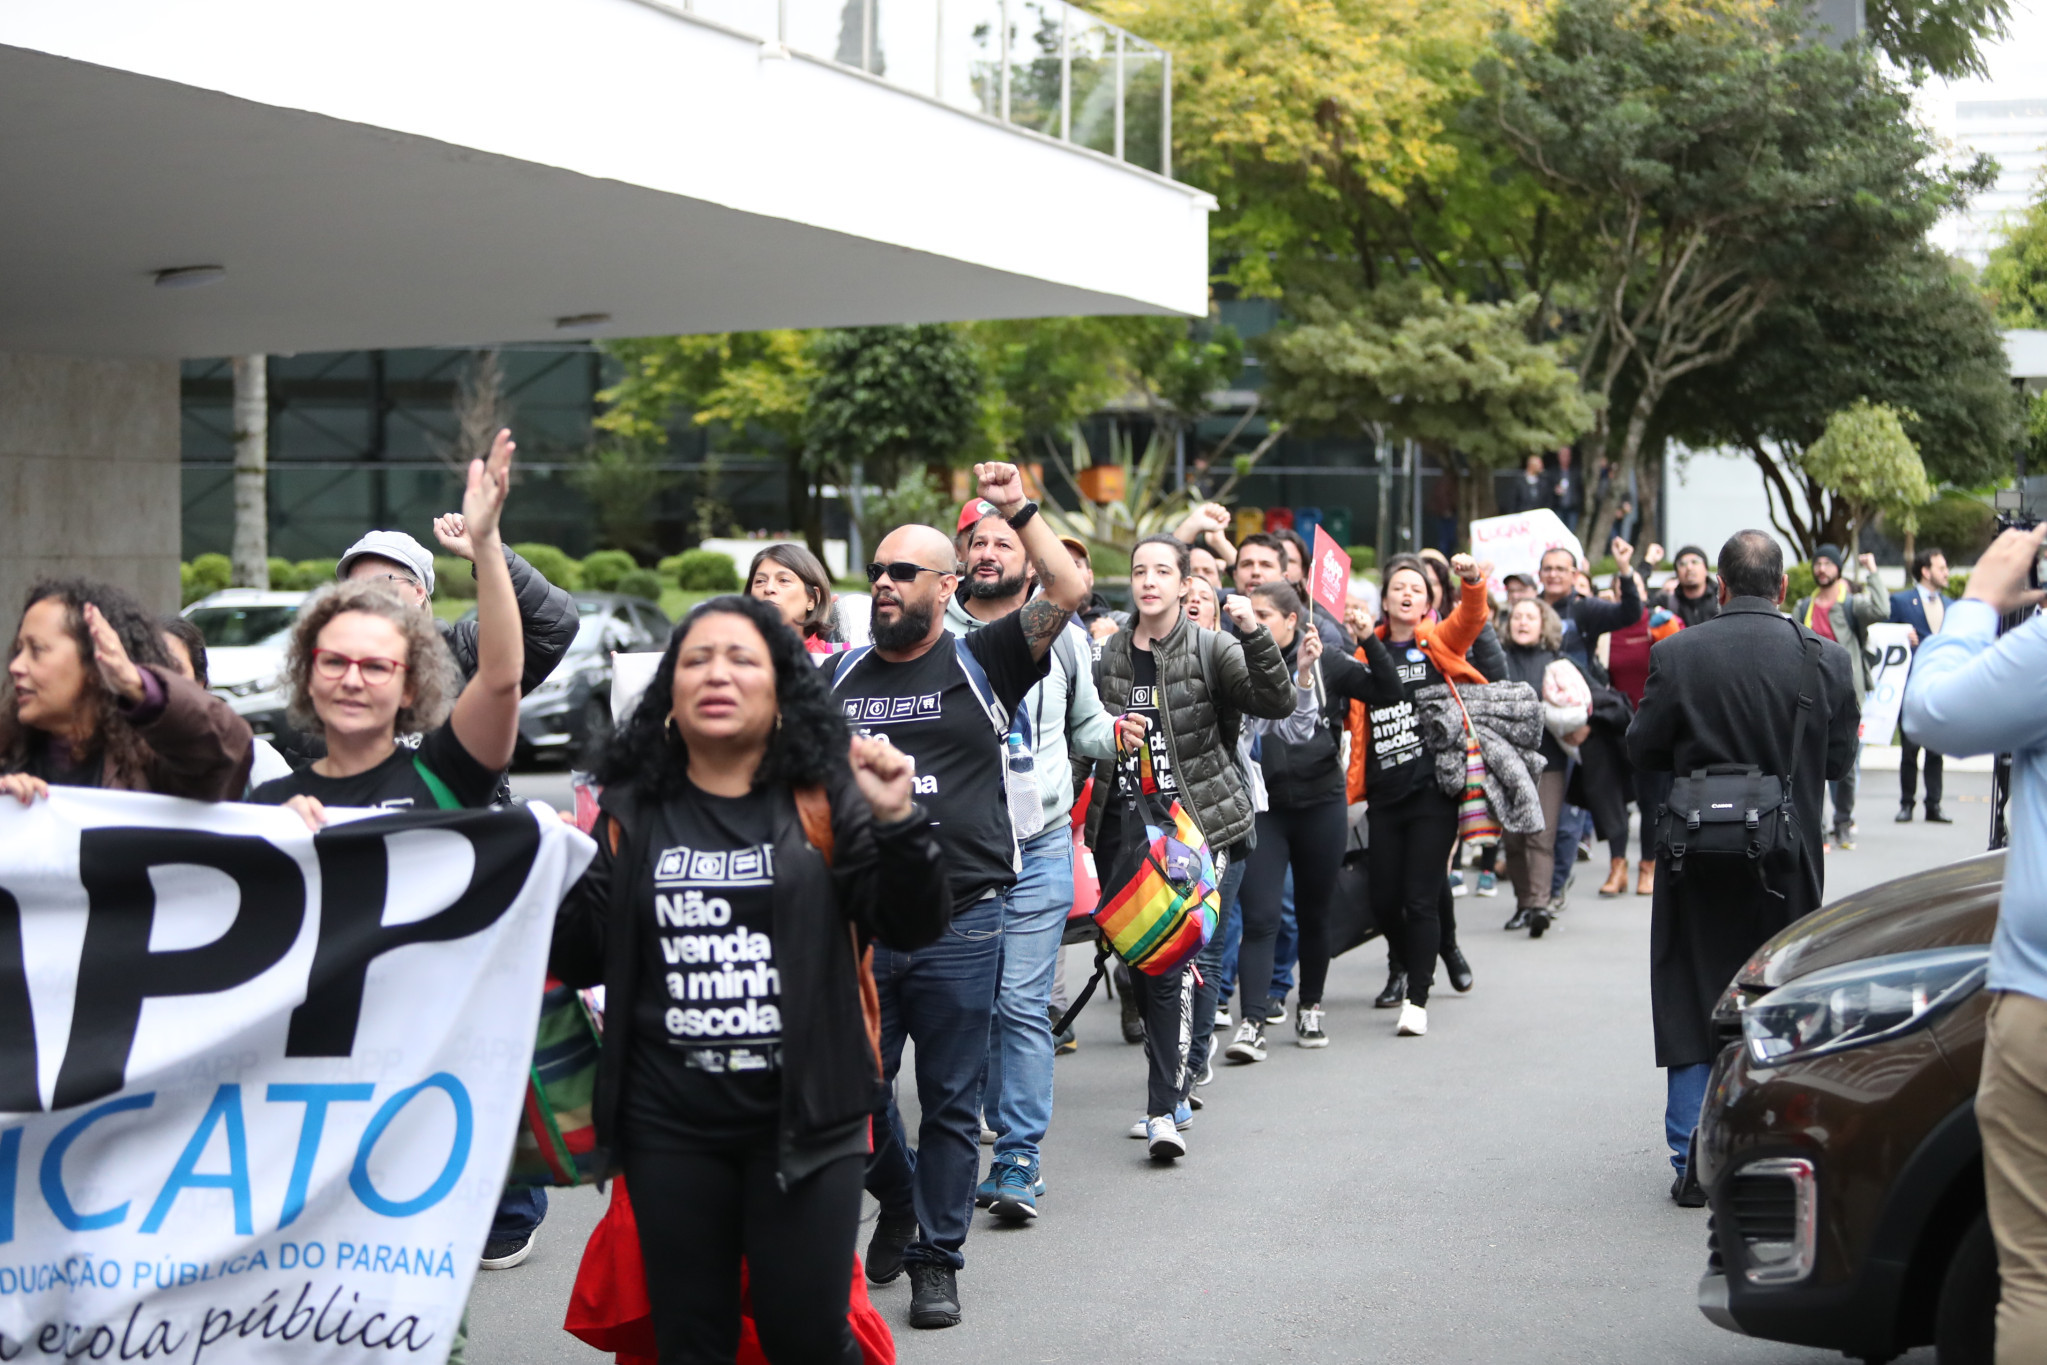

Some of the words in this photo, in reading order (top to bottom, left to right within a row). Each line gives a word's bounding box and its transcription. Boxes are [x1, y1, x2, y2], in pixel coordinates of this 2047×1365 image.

[655, 890, 732, 928] Não
[0, 813, 541, 1112] PP
[660, 926, 772, 964] venda
[666, 972, 685, 1000] a
[688, 962, 782, 1000] minh
[133, 1250, 268, 1289] PÚBLICA
[279, 1242, 325, 1270] DO
[336, 1242, 456, 1279] PARANÁ
[193, 1281, 434, 1365] pública
